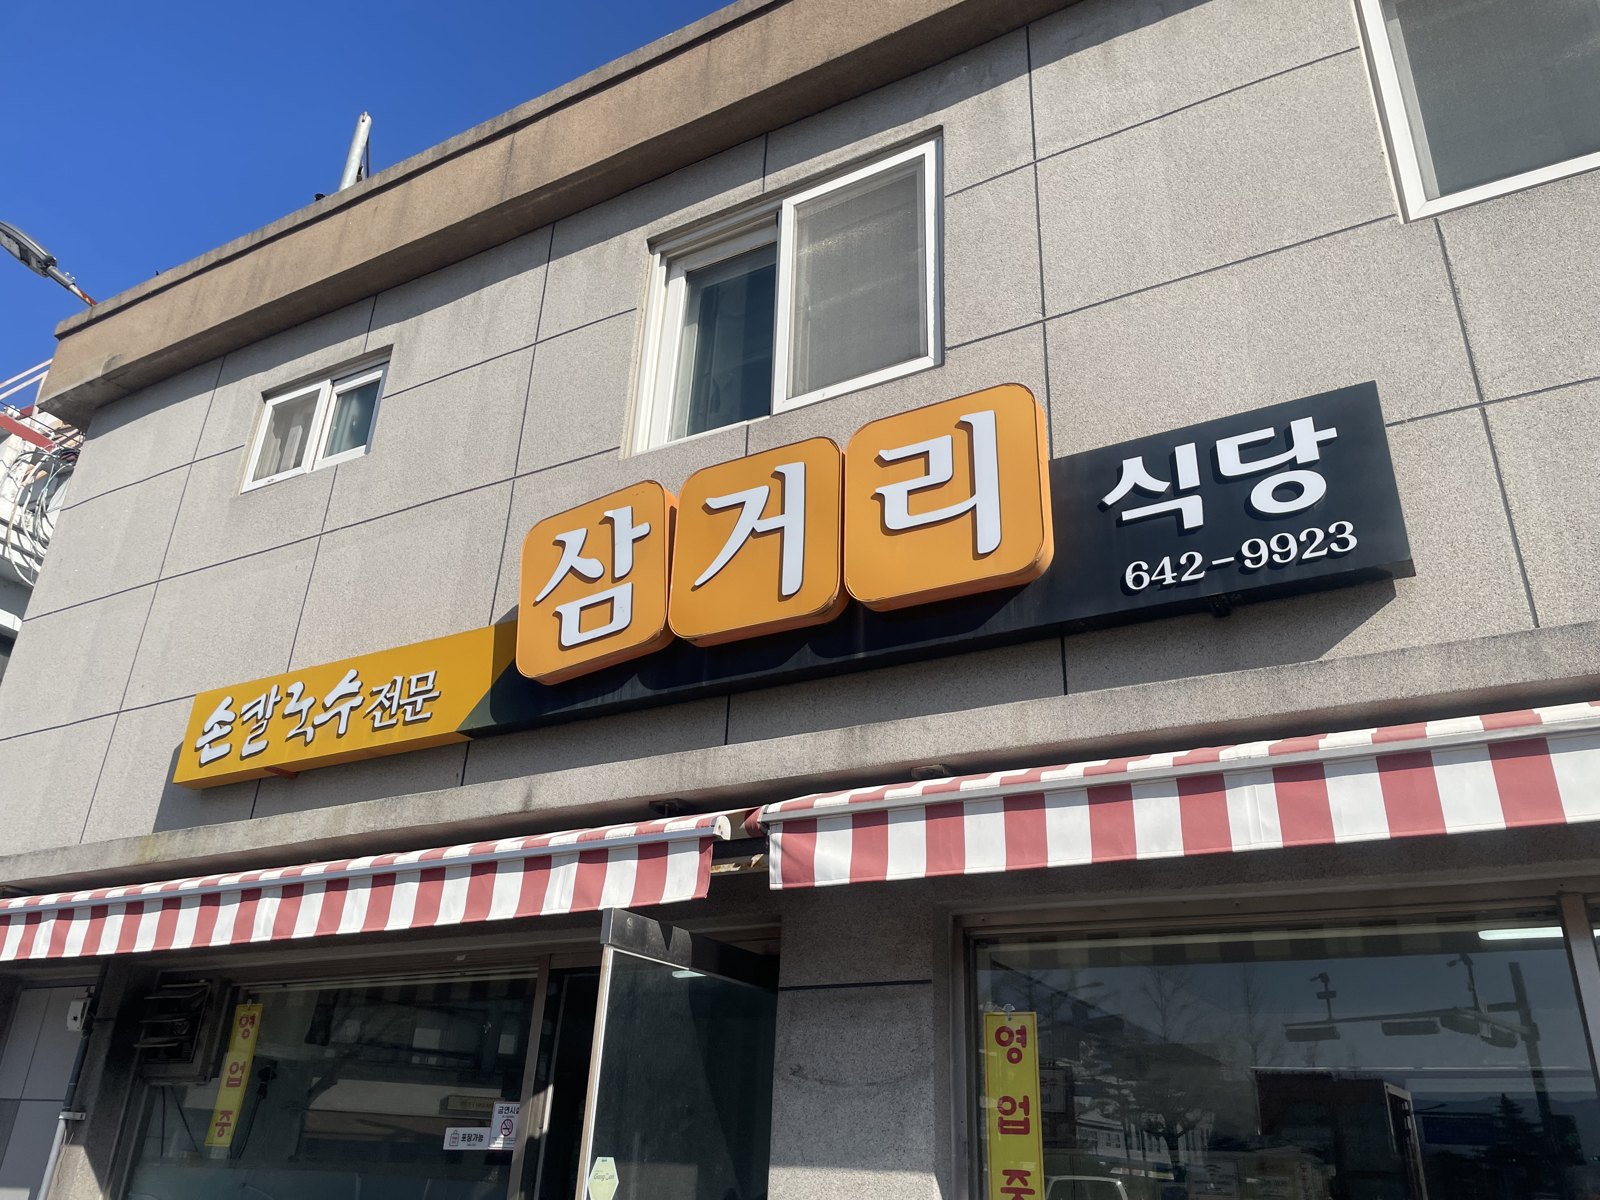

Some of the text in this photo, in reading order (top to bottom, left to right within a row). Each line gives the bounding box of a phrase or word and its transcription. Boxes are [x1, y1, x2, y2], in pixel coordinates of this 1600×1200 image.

[535, 410, 1338, 648] 삼거리 식당
[1125, 520, 1358, 591] 642-9923
[195, 668, 440, 764] 손칼국수 전문
